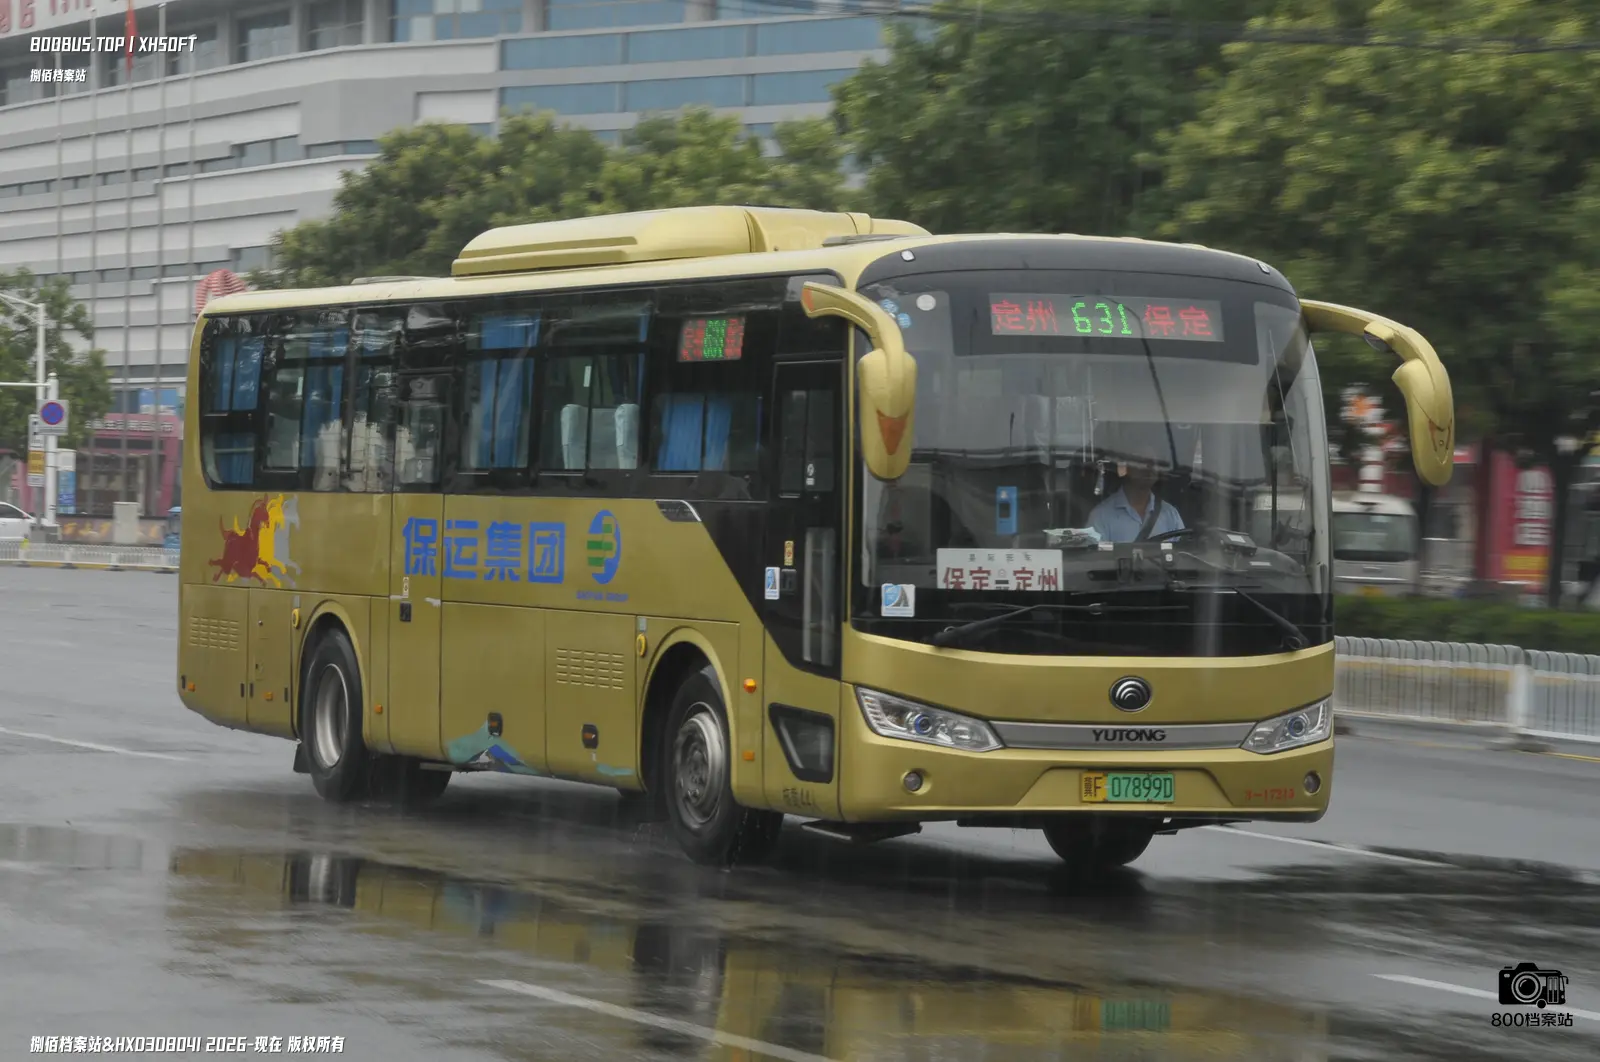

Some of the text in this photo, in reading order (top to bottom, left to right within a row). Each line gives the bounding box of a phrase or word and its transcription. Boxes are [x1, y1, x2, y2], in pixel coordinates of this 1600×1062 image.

[991, 299, 1213, 336] 定州 631 保定
[402, 516, 566, 584] 保运集团
[943, 566, 1059, 591] 保定 定州
[1092, 729, 1167, 742] YUTONG
